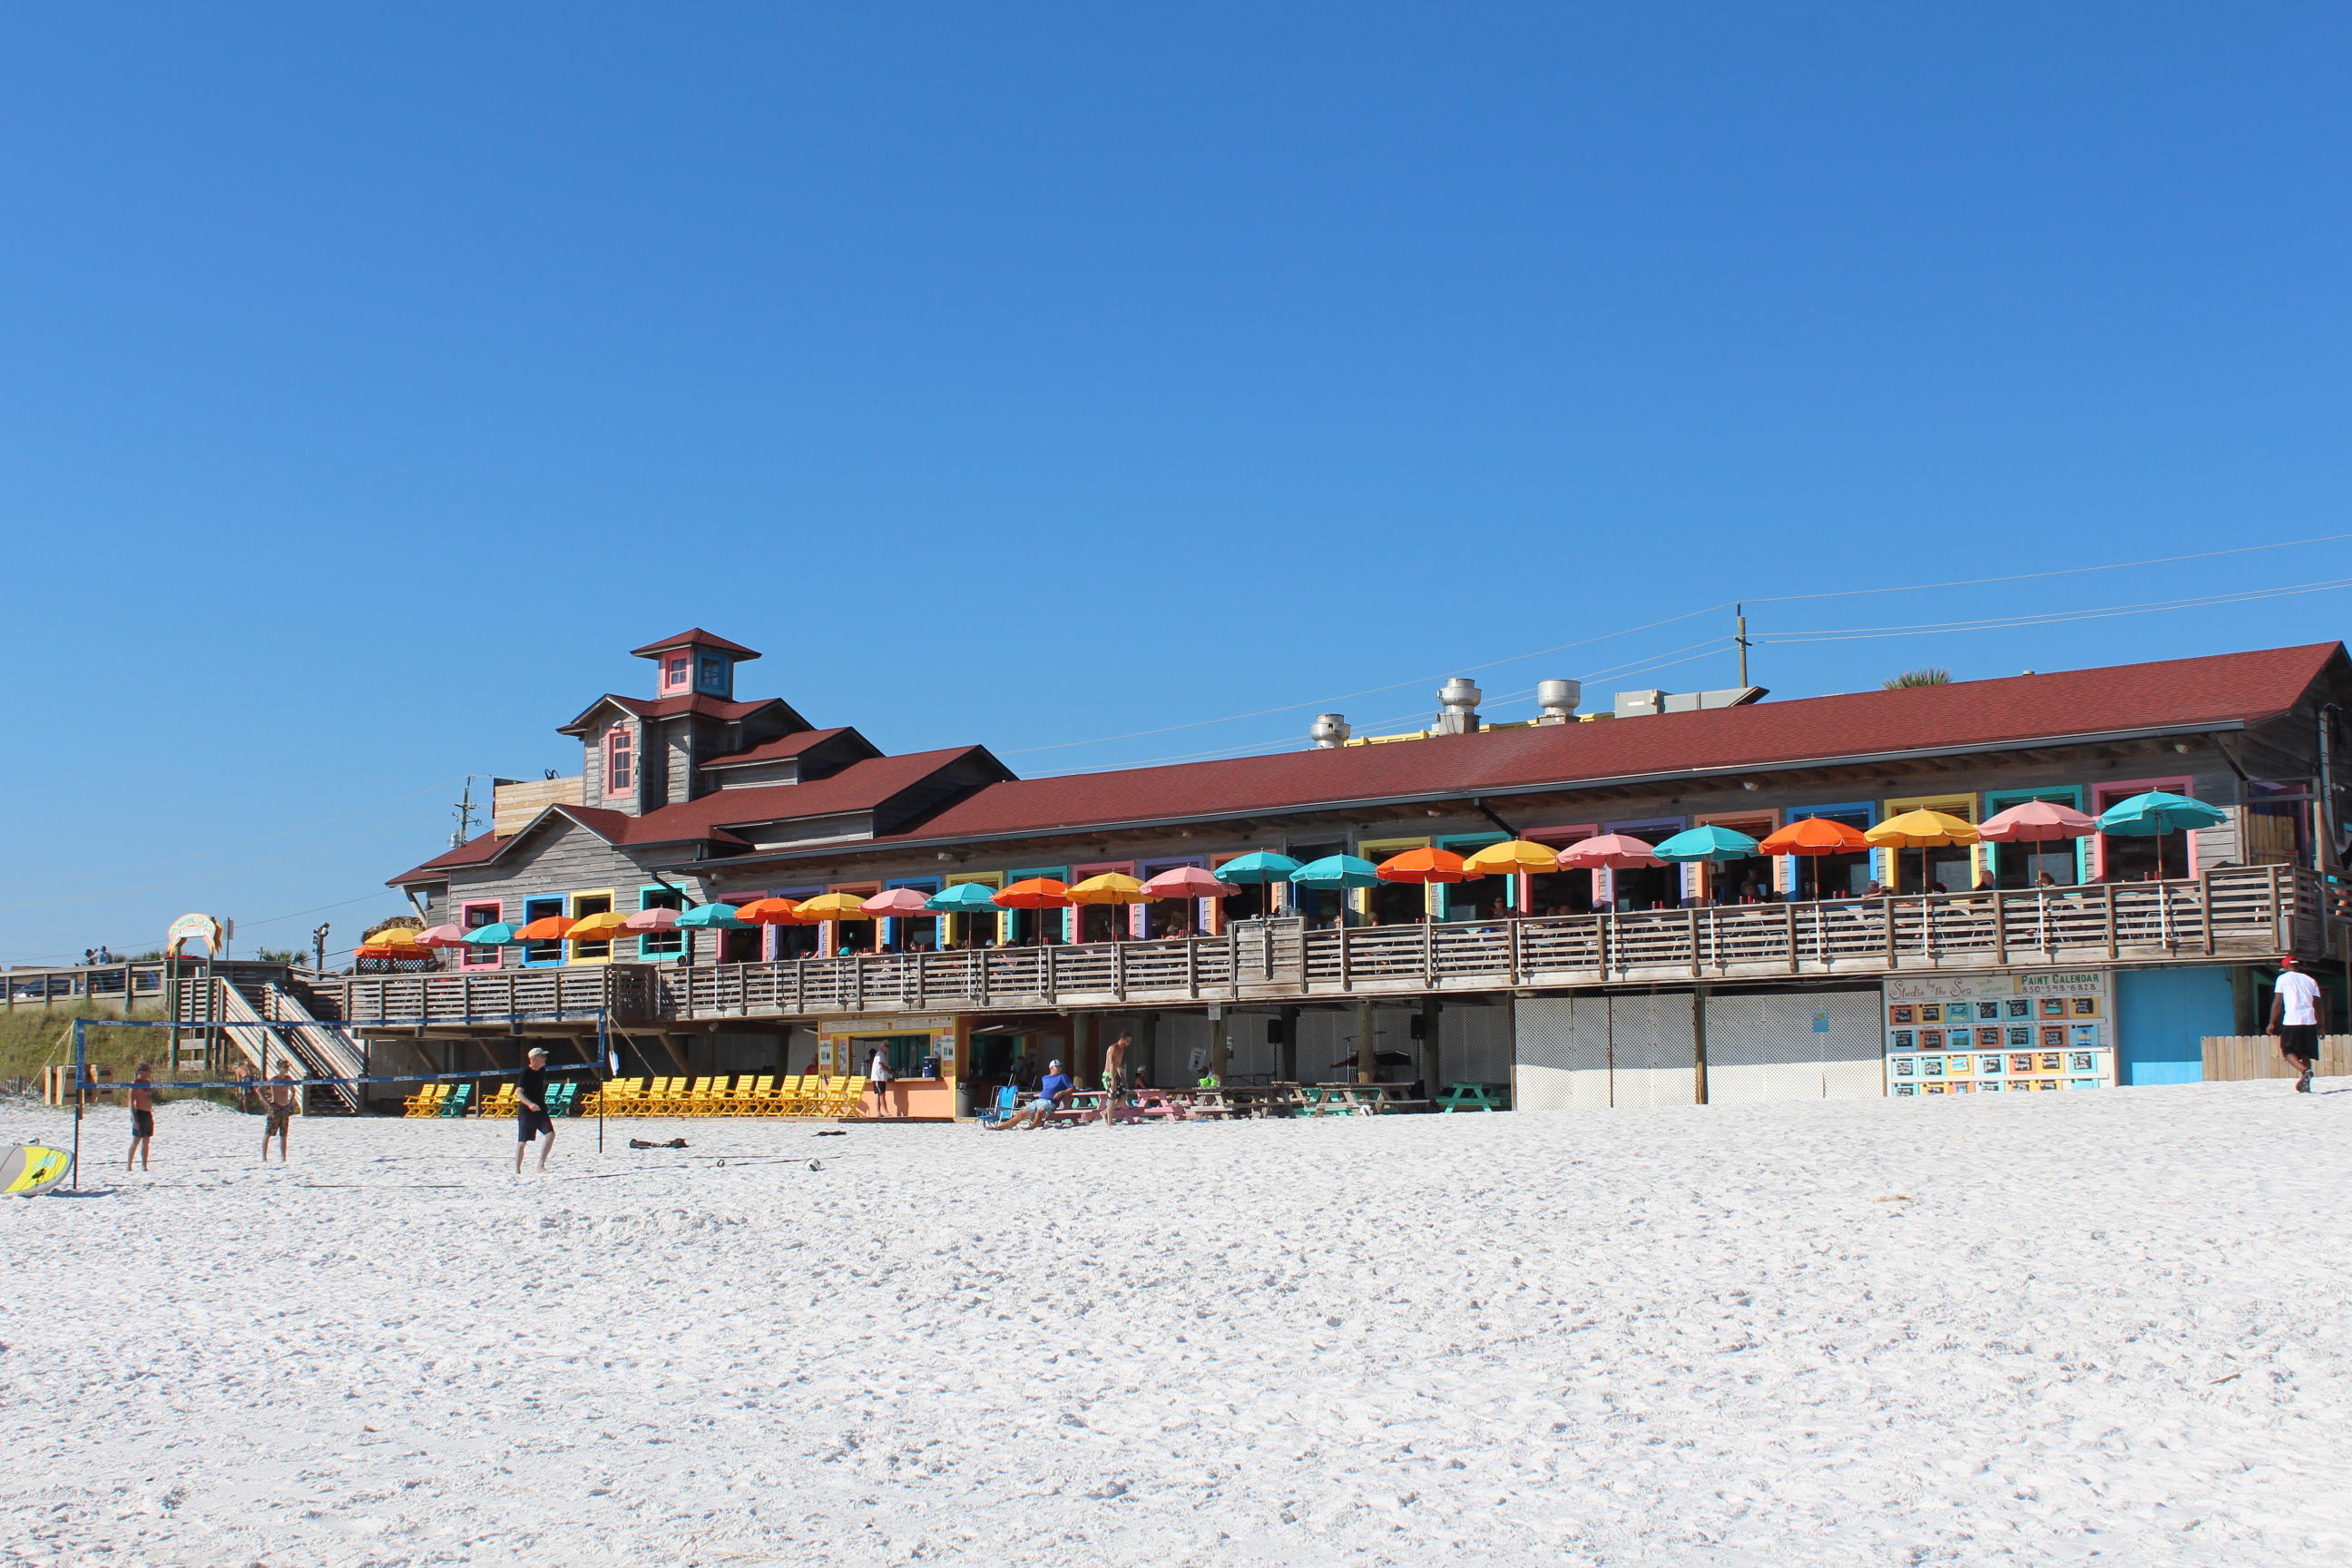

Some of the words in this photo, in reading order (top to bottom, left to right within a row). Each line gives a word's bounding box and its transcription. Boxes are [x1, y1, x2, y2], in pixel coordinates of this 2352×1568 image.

[2022, 975, 2049, 985] PAINT
[2053, 973, 2099, 984] CALENDAR
[1888, 980, 1925, 999] Studio
[1926, 979, 1935, 991] by
[1949, 978, 1973, 997] Sea
